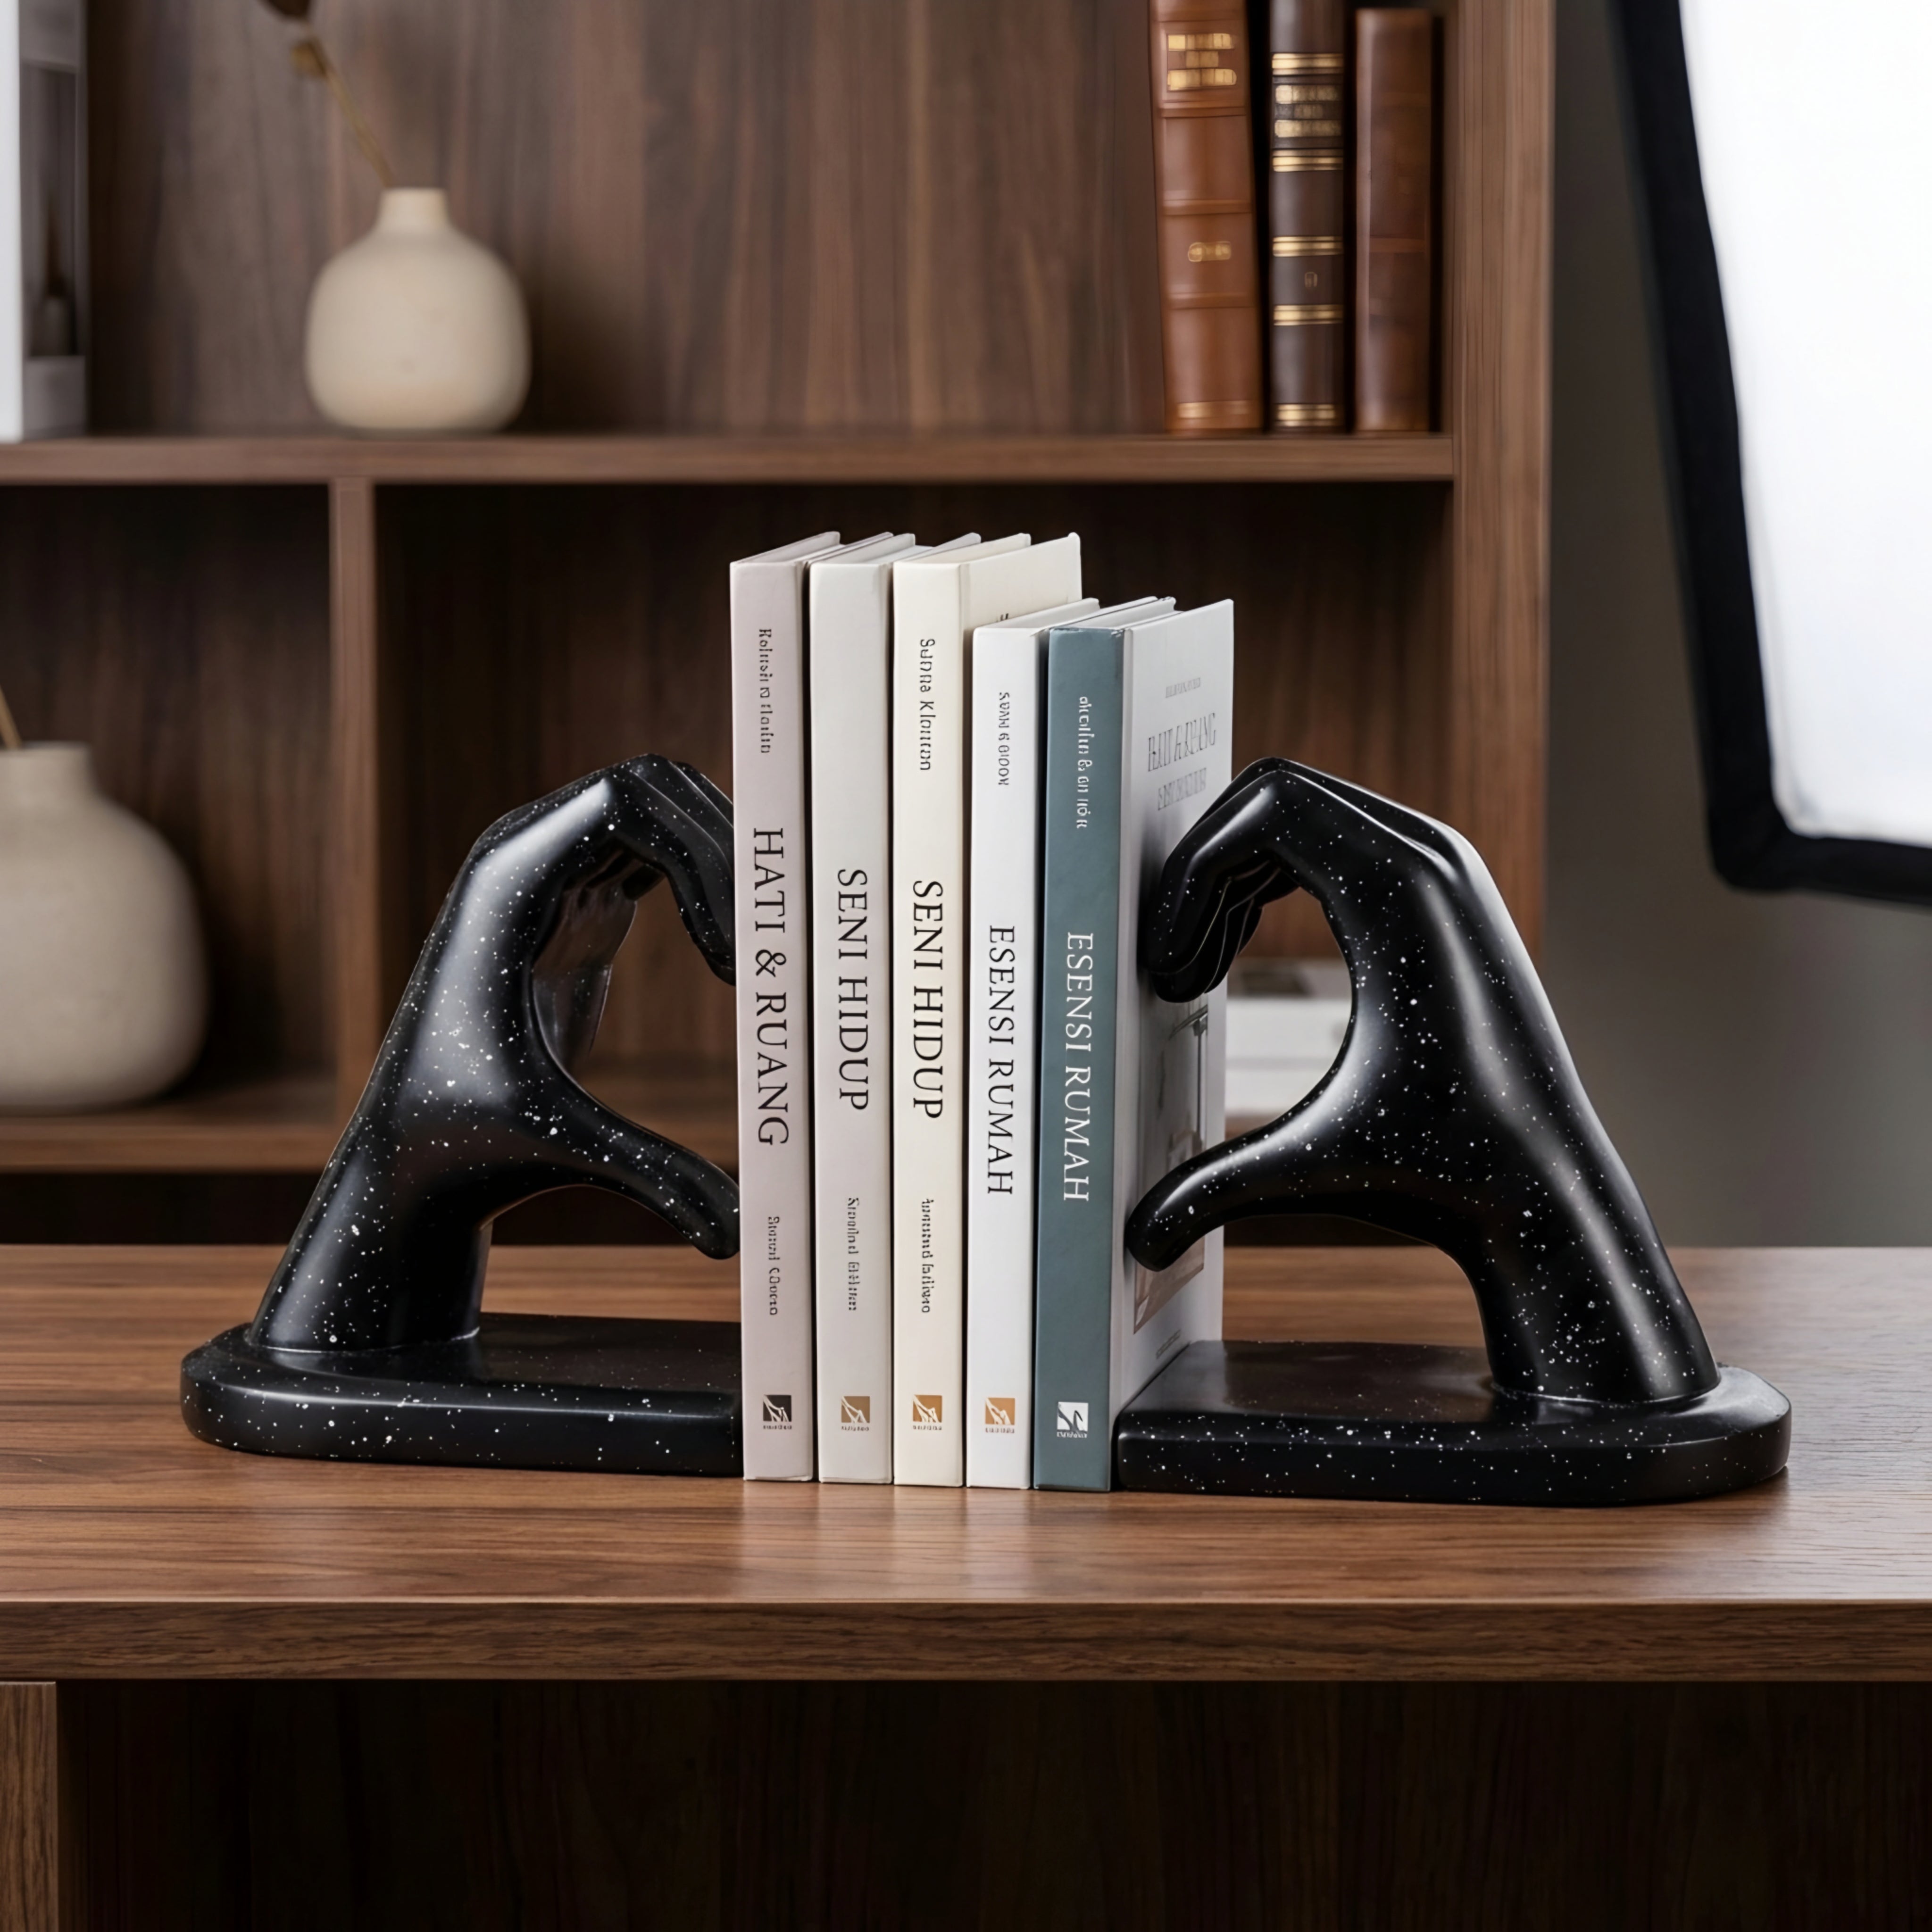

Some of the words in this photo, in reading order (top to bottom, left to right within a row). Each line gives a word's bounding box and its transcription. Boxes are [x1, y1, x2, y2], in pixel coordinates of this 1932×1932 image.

[753, 828, 785, 933] HATI
[837, 869, 868, 959] SENI
[913, 880, 943, 970] SENI
[755, 949, 787, 978] &
[988, 925, 1016, 1045] ESENSI
[1066, 932, 1093, 1052] ESENSI
[756, 991, 789, 1146] RUANG
[838, 976, 869, 1110] HIDUP
[913, 985, 943, 1118] HIDUP
[987, 1058, 1014, 1195] RUMAH
[1063, 1065, 1091, 1202] RUMAH
